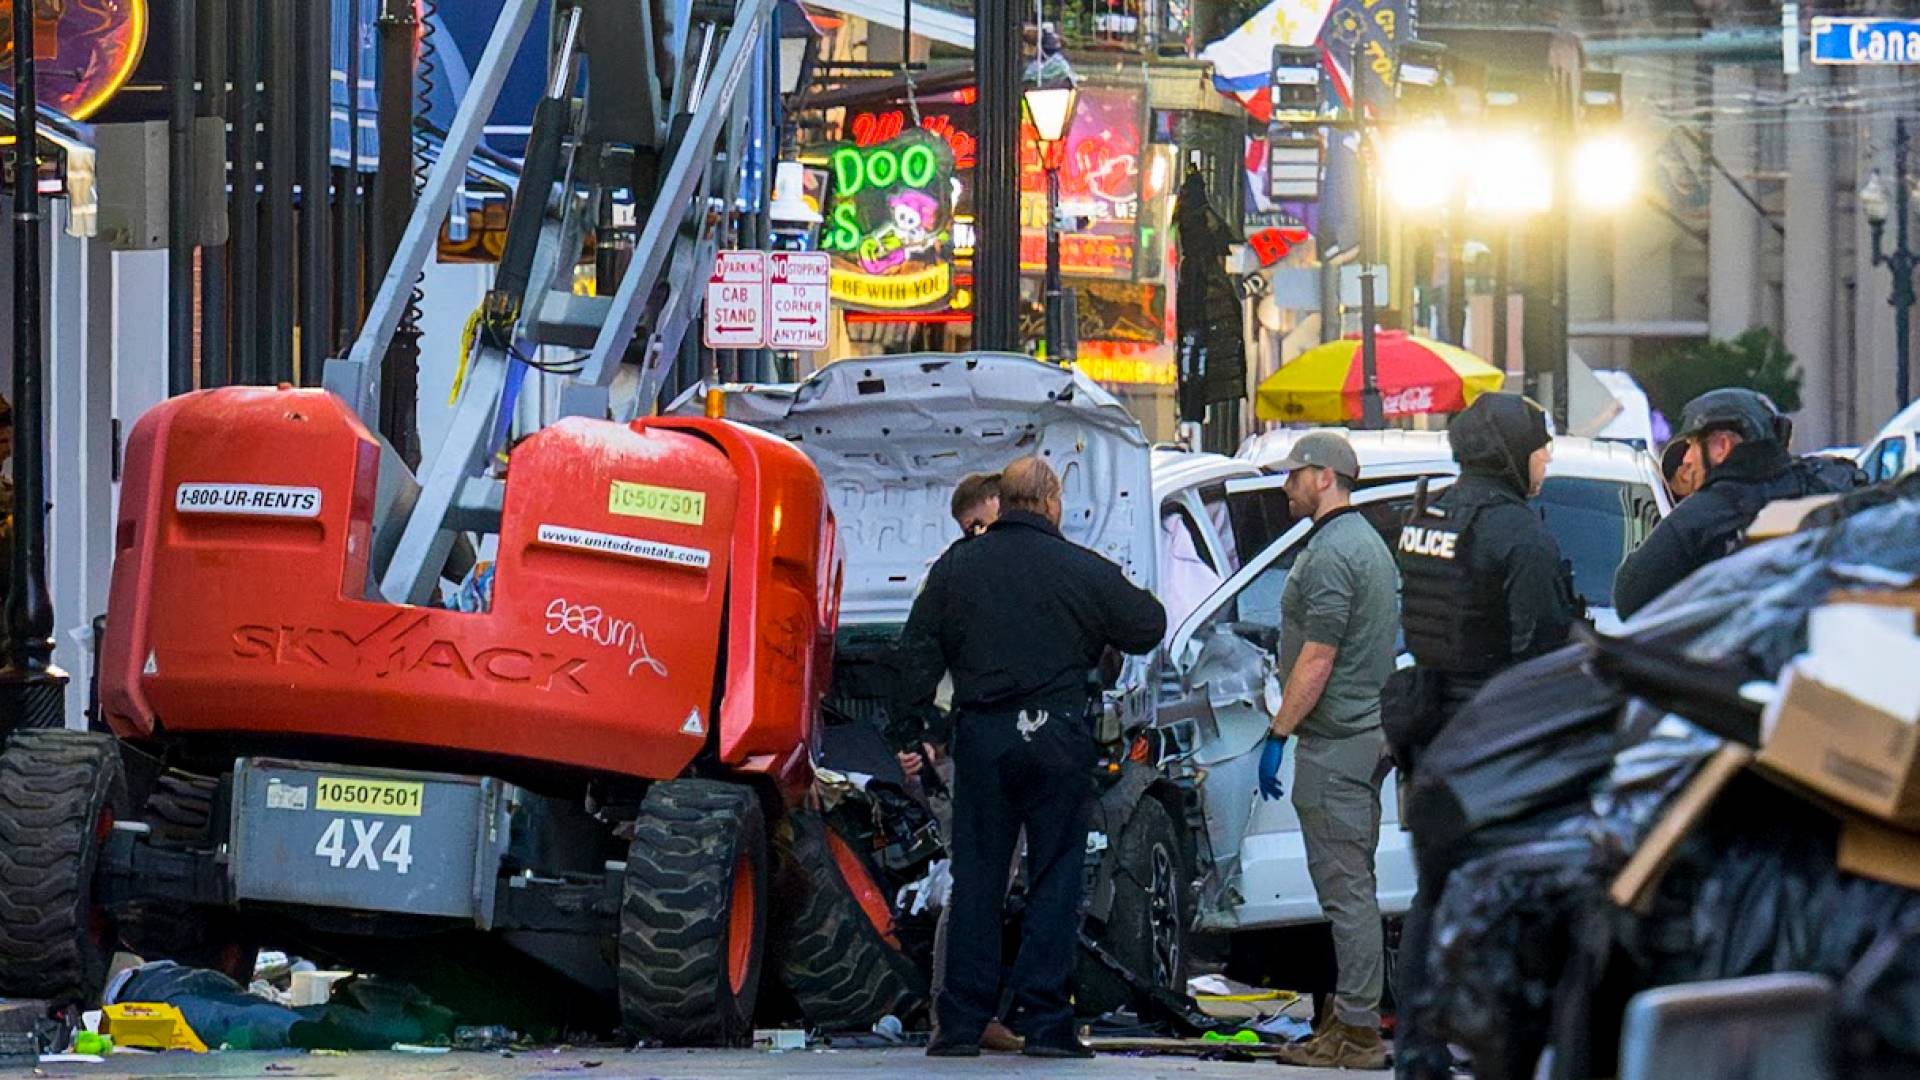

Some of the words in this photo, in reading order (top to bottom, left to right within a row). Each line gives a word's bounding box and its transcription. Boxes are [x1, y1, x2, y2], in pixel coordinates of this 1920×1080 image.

[1849, 23, 1920, 61] Cana
[834, 144, 937, 197] DOO
[722, 287, 748, 303] CAB
[792, 286, 806, 298] TO
[842, 277, 861, 293] BE
[867, 281, 907, 300] WITH
[714, 307, 757, 323] STAND
[775, 299, 822, 313] CORNER
[774, 328, 823, 342] ANYTIME
[180, 488, 316, 511] 1-800-UR-RENTS
[541, 529, 706, 565] www.unitedrentals.com
[319, 783, 419, 806] 10507501
[315, 818, 413, 875] 4X4
